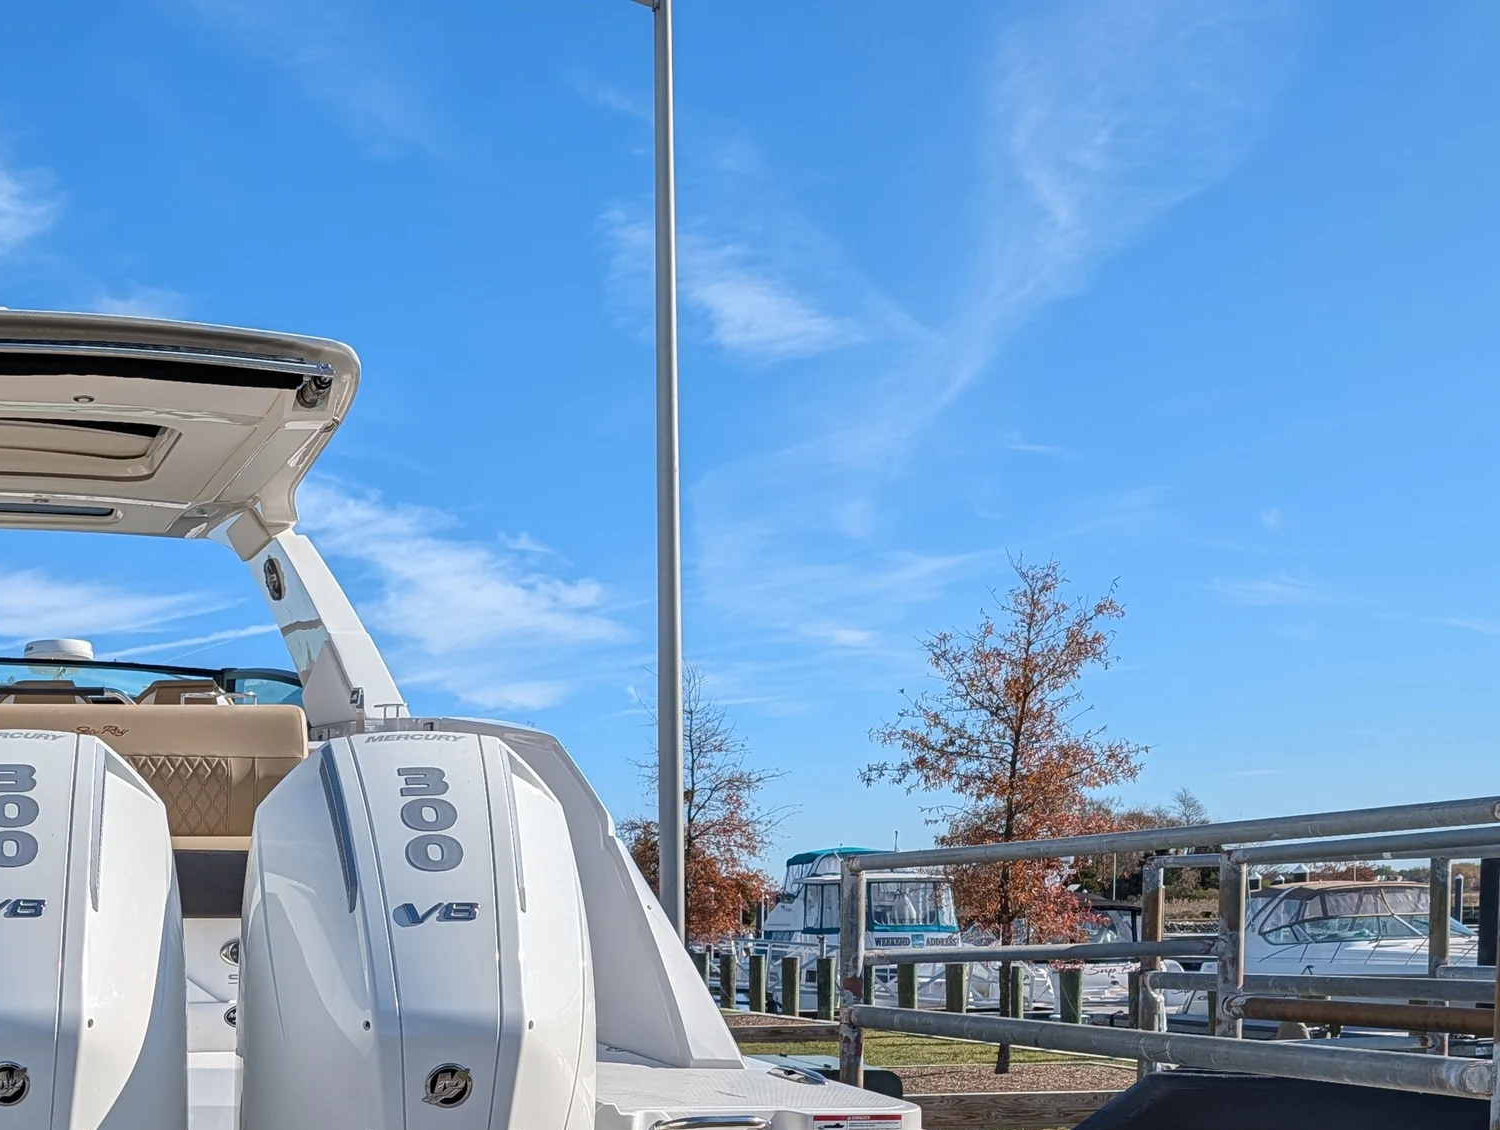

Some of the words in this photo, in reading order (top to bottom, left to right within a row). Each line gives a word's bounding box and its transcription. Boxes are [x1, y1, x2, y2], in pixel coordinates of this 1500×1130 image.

[364, 733, 467, 744] MERCURY
[396, 766, 464, 872] 300
[393, 902, 481, 927] V8
[875, 937, 910, 947] WEEKEND
[926, 937, 957, 947] ADDRESS
